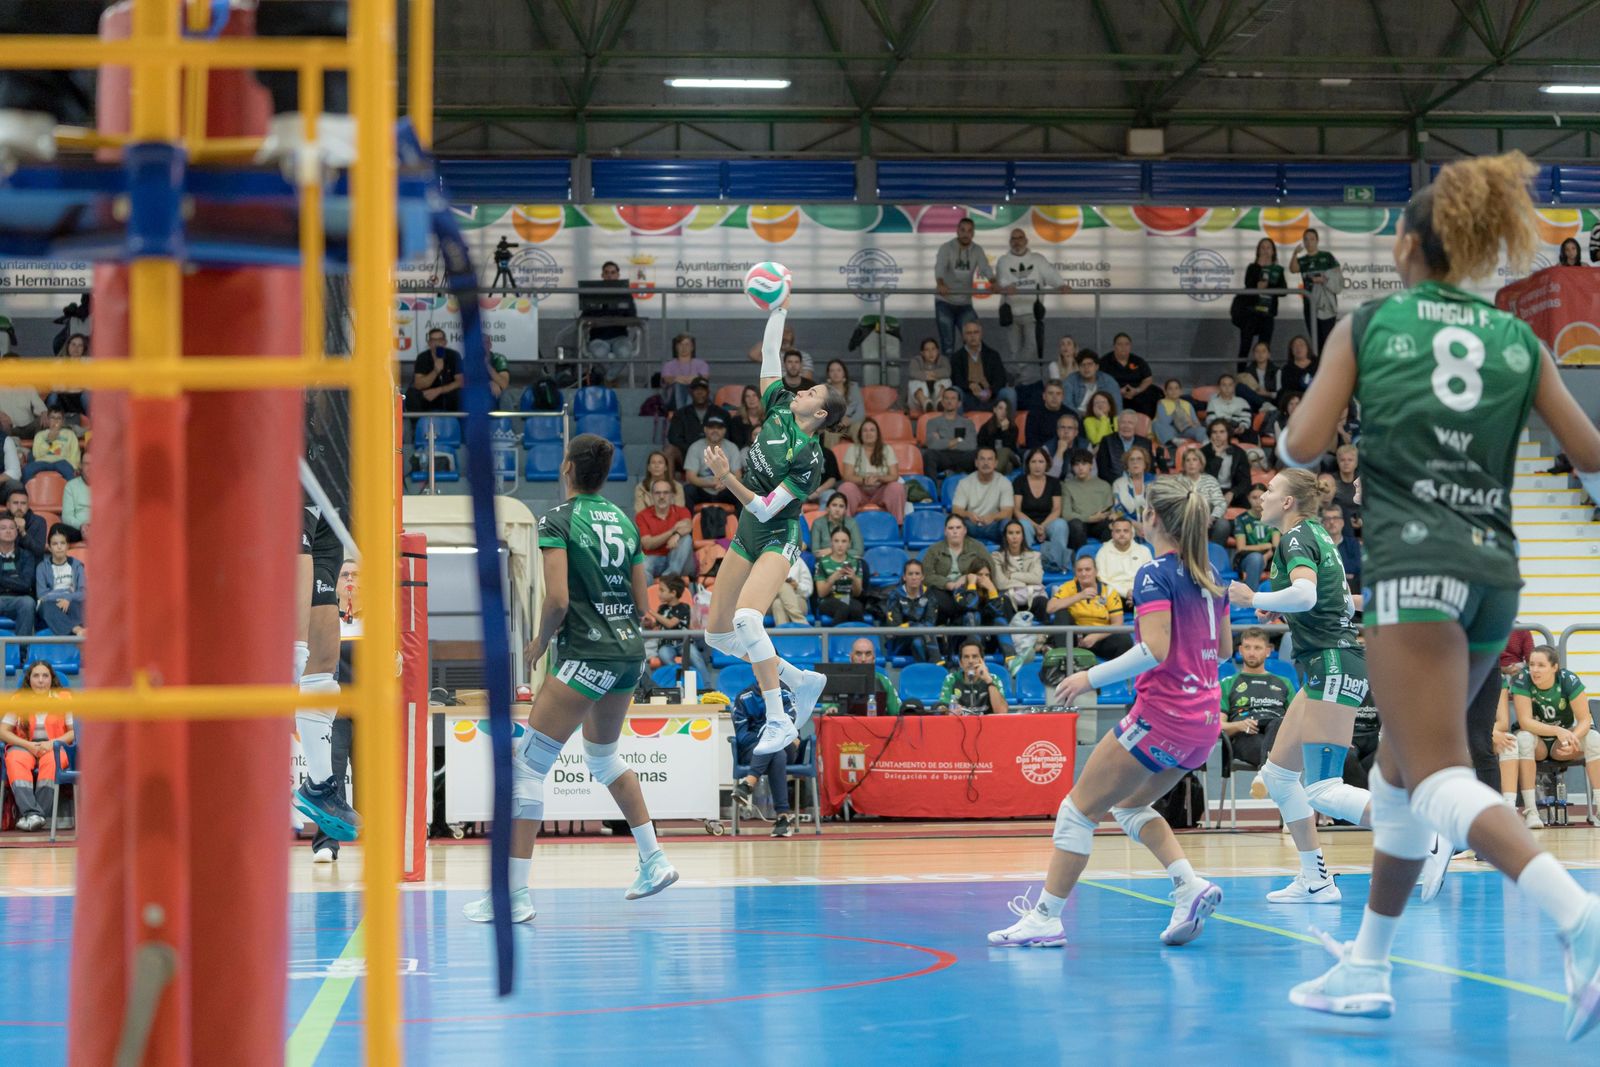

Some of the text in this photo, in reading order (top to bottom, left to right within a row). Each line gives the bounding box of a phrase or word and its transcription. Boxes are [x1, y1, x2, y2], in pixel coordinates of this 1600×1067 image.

[1051, 261, 1111, 271] miento de
[15, 274, 87, 287] Hermanas
[676, 277, 703, 288] Dos
[707, 277, 744, 288] Herm
[1067, 278, 1111, 287] manas
[1343, 277, 1404, 289] Dos Herm
[425, 320, 506, 330] Ayuntato de
[450, 333, 506, 342] Henas
[1431, 326, 1486, 412] 8
[589, 510, 619, 523] LOUISE
[591, 523, 626, 568] 15
[1201, 587, 1217, 640] 1
[577, 661, 617, 691] berlin
[1355, 711, 1377, 719] nicaja
[1541, 704, 1556, 719] 10
[650, 750, 667, 764] de
[1016, 755, 1067, 764] Dos Hermanas
[869, 761, 926, 769] AYUNTAMIENTO
[554, 769, 584, 783] Dos
[884, 772, 927, 780] Delegación
[943, 773, 978, 781] Deportes
[553, 787, 591, 796] Deportes
